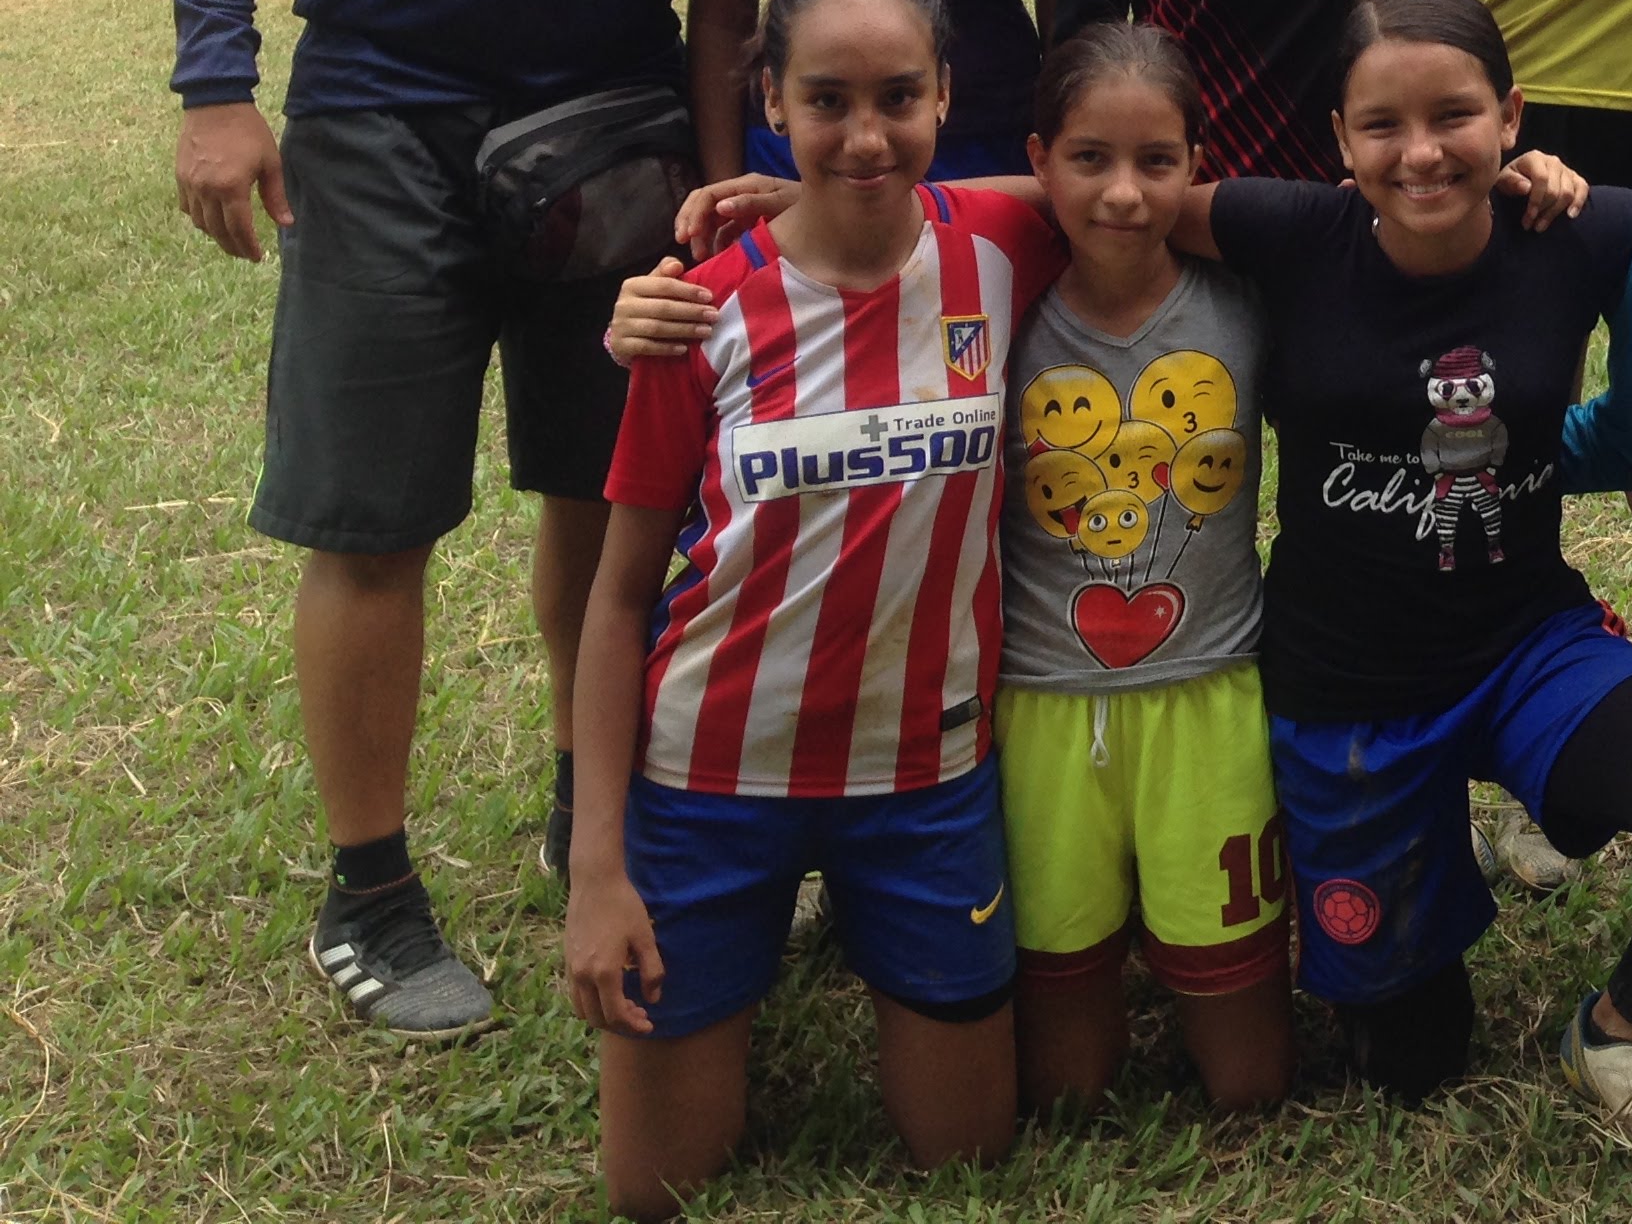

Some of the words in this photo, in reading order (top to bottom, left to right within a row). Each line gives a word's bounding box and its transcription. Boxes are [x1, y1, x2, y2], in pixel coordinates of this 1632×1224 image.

[893, 415, 945, 432] Trade
[952, 408, 996, 425] Online
[1445, 429, 1485, 438] COOL
[739, 425, 995, 496] Plus500
[1329, 441, 1375, 463] Take
[1379, 452, 1402, 464] me
[1406, 452, 1420, 464] to
[1218, 814, 1288, 928] 10
